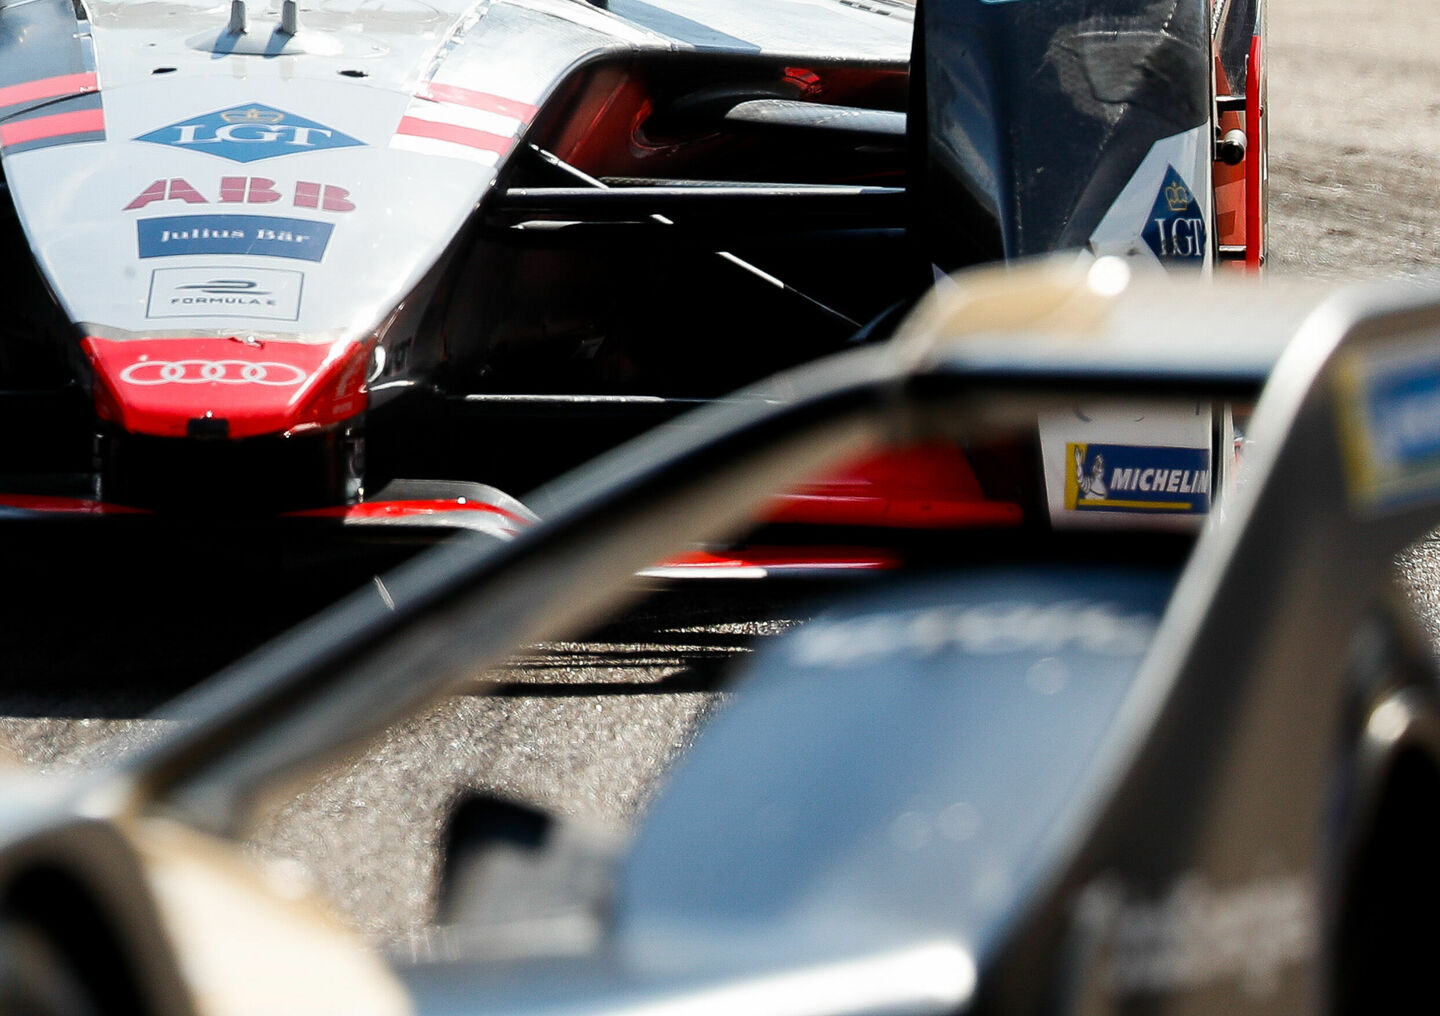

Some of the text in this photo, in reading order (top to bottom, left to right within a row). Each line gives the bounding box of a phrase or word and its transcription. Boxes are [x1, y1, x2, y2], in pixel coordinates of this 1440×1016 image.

[170, 122, 334, 147] LGT
[121, 176, 357, 213] ABB
[160, 228, 312, 244] Julius Bär
[1153, 216, 1203, 257] LGT
[170, 296, 261, 306] FORMULA
[1110, 467, 1209, 494] MICHELIN
